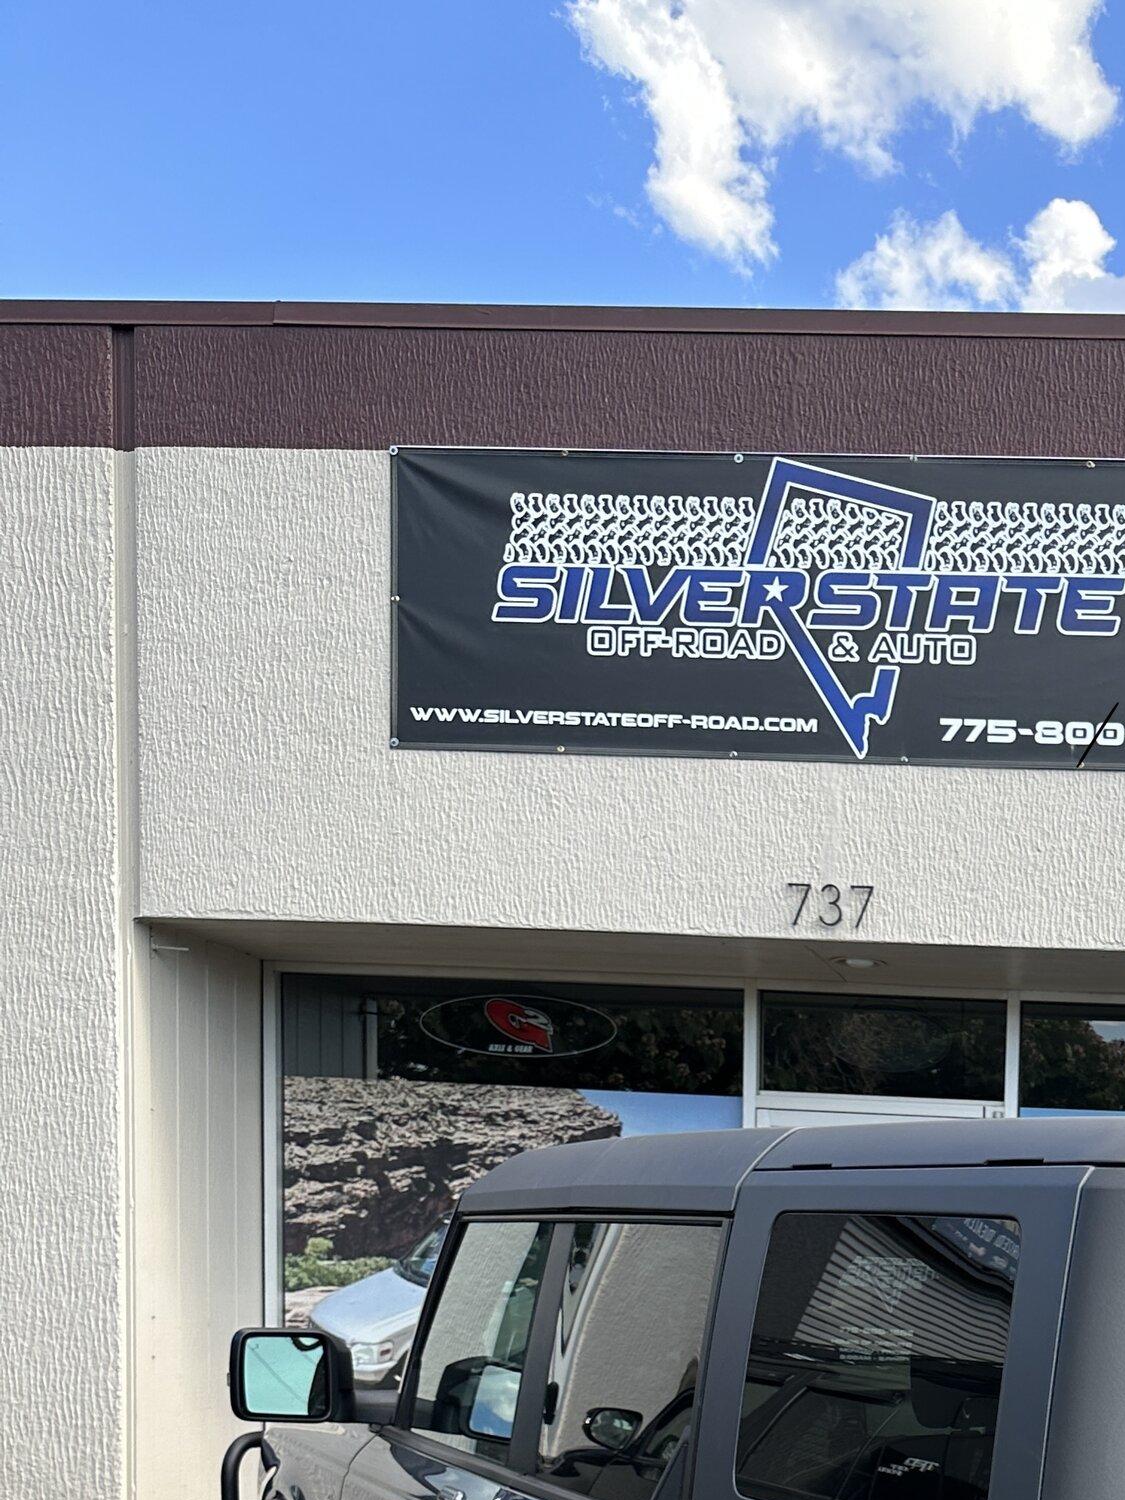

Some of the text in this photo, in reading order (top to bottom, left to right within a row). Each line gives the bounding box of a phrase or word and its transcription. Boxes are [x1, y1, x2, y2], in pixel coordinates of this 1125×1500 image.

[587, 626, 977, 665] OFF-ROAD & AUTO
[410, 706, 819, 733] WWW.SILVERSTATEOFF-ROAD.COM
[787, 883, 874, 928] 737
